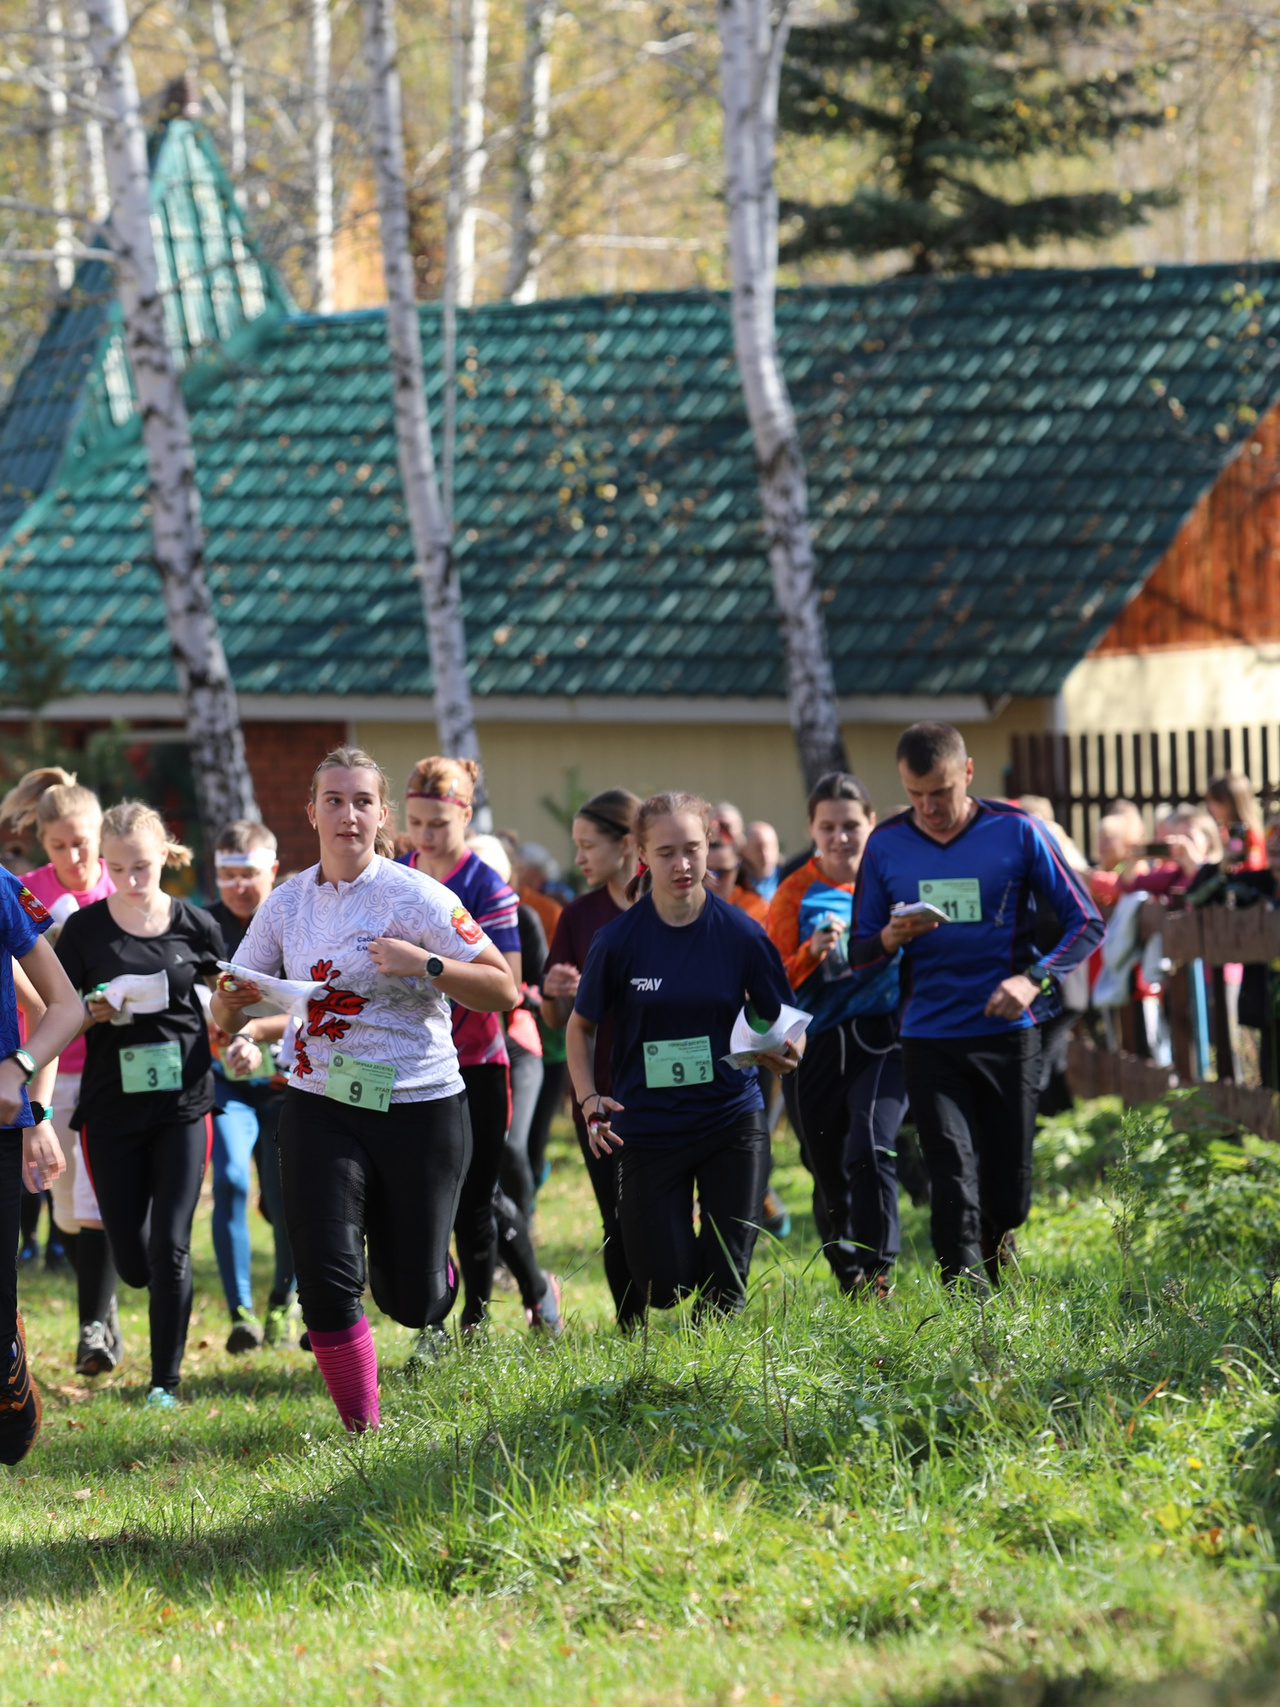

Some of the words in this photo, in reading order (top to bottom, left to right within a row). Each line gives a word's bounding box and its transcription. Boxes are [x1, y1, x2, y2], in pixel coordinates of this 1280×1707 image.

[942, 900, 959, 919] 11
[969, 905, 976, 919] 2
[630, 978, 663, 992] RAY
[147, 1067, 159, 1088] 3
[671, 1062, 686, 1084] 9
[699, 1066, 707, 1081] 2
[348, 1081, 363, 1104] 9
[378, 1093, 385, 1109] 1
